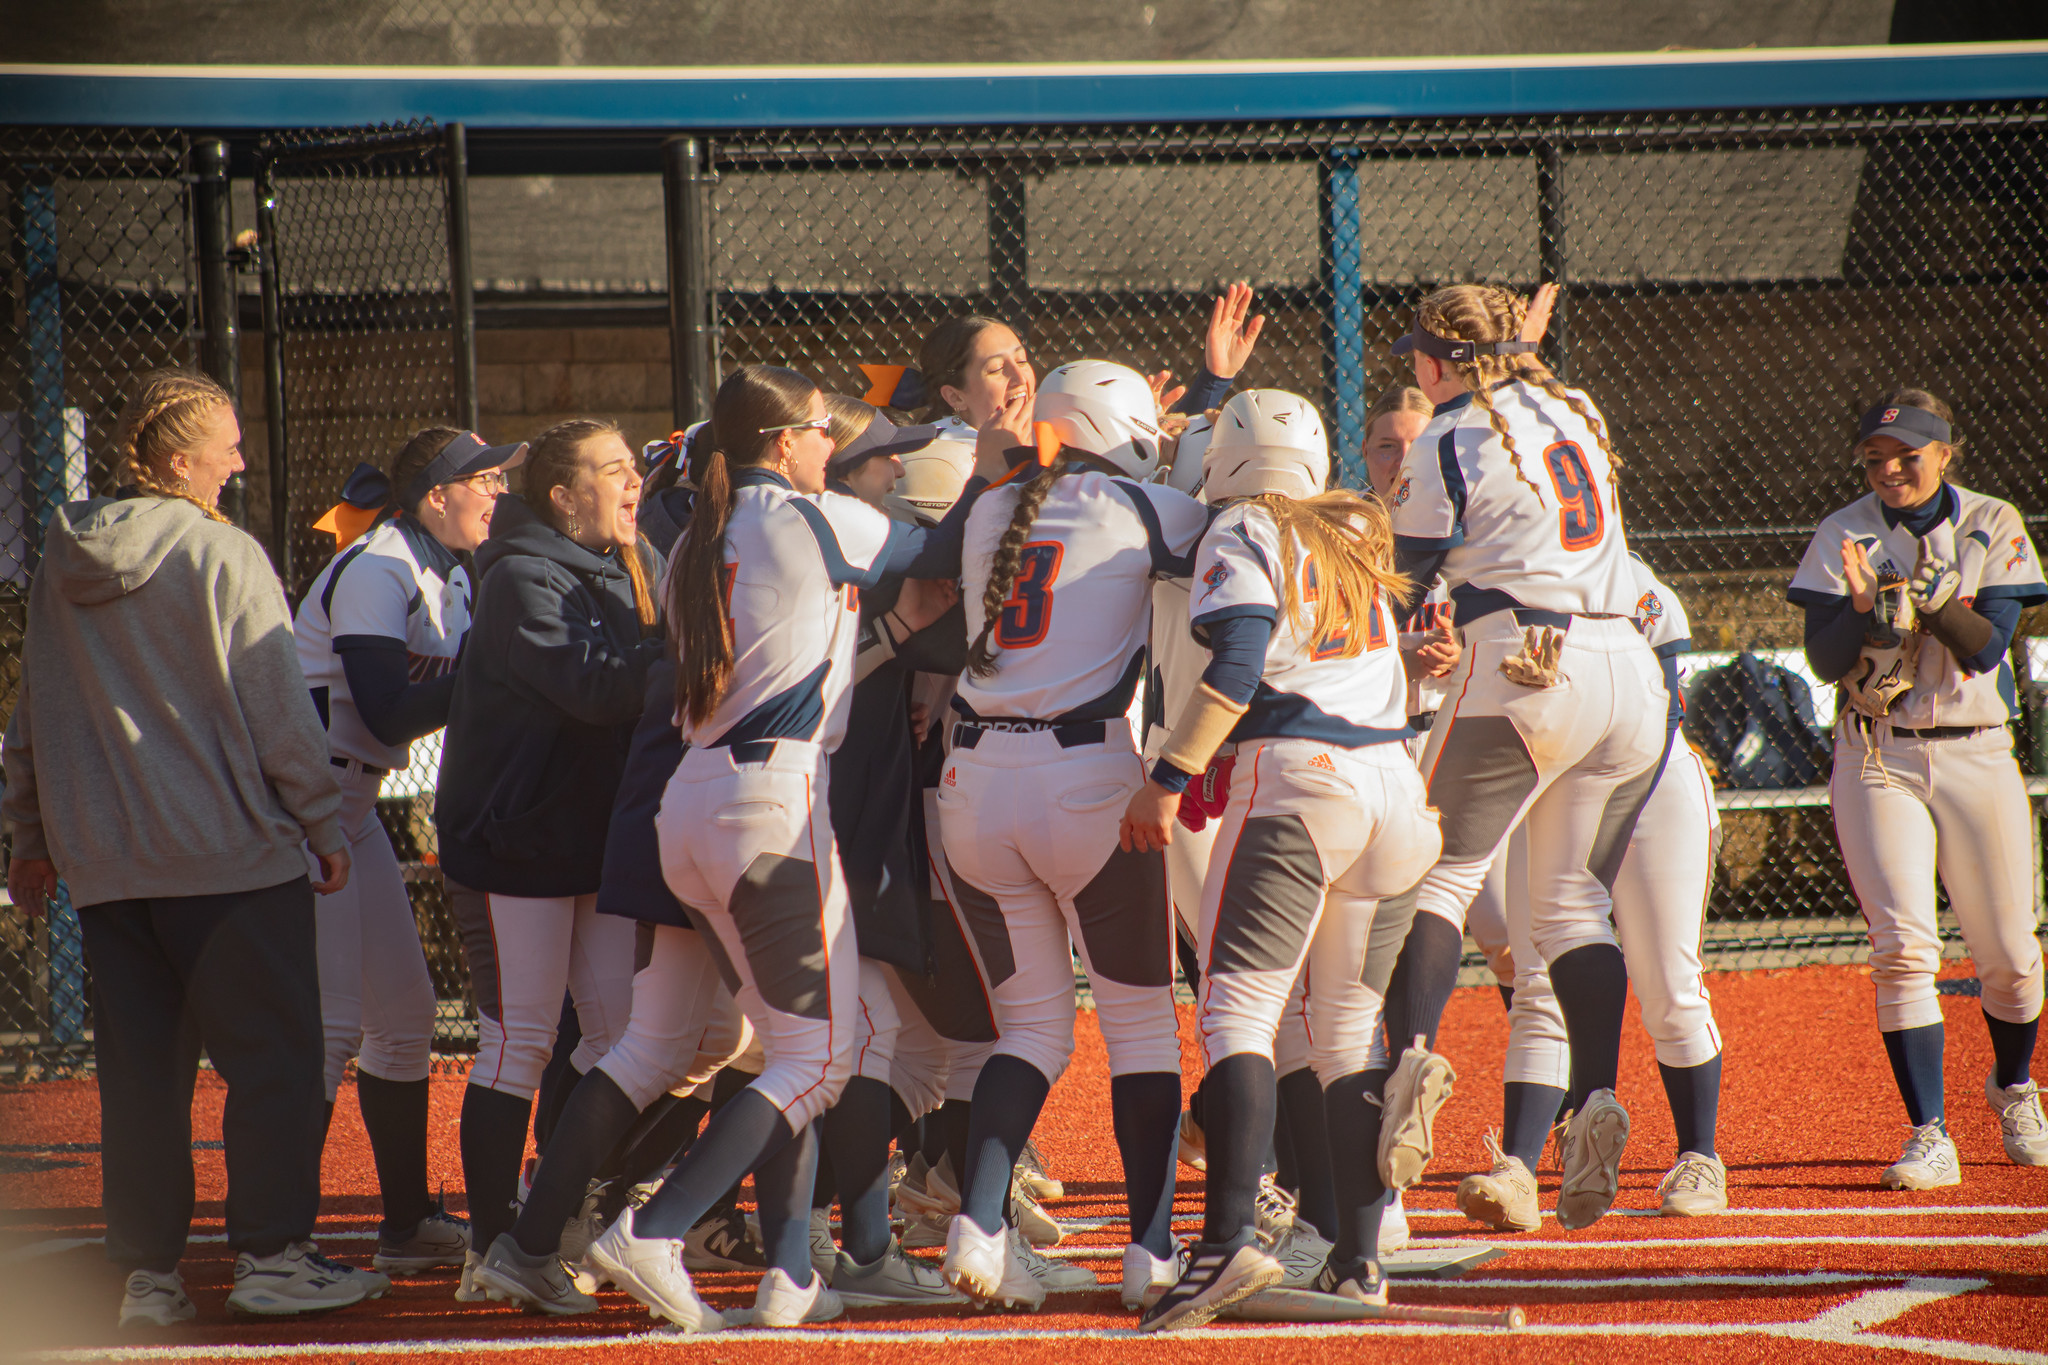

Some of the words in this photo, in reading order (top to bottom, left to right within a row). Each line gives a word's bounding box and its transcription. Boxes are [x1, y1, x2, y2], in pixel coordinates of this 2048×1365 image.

[1135, 419, 1156, 434] EASTON
[1881, 408, 1900, 423] S
[1542, 440, 1605, 552] 9
[994, 540, 1065, 650] 3
